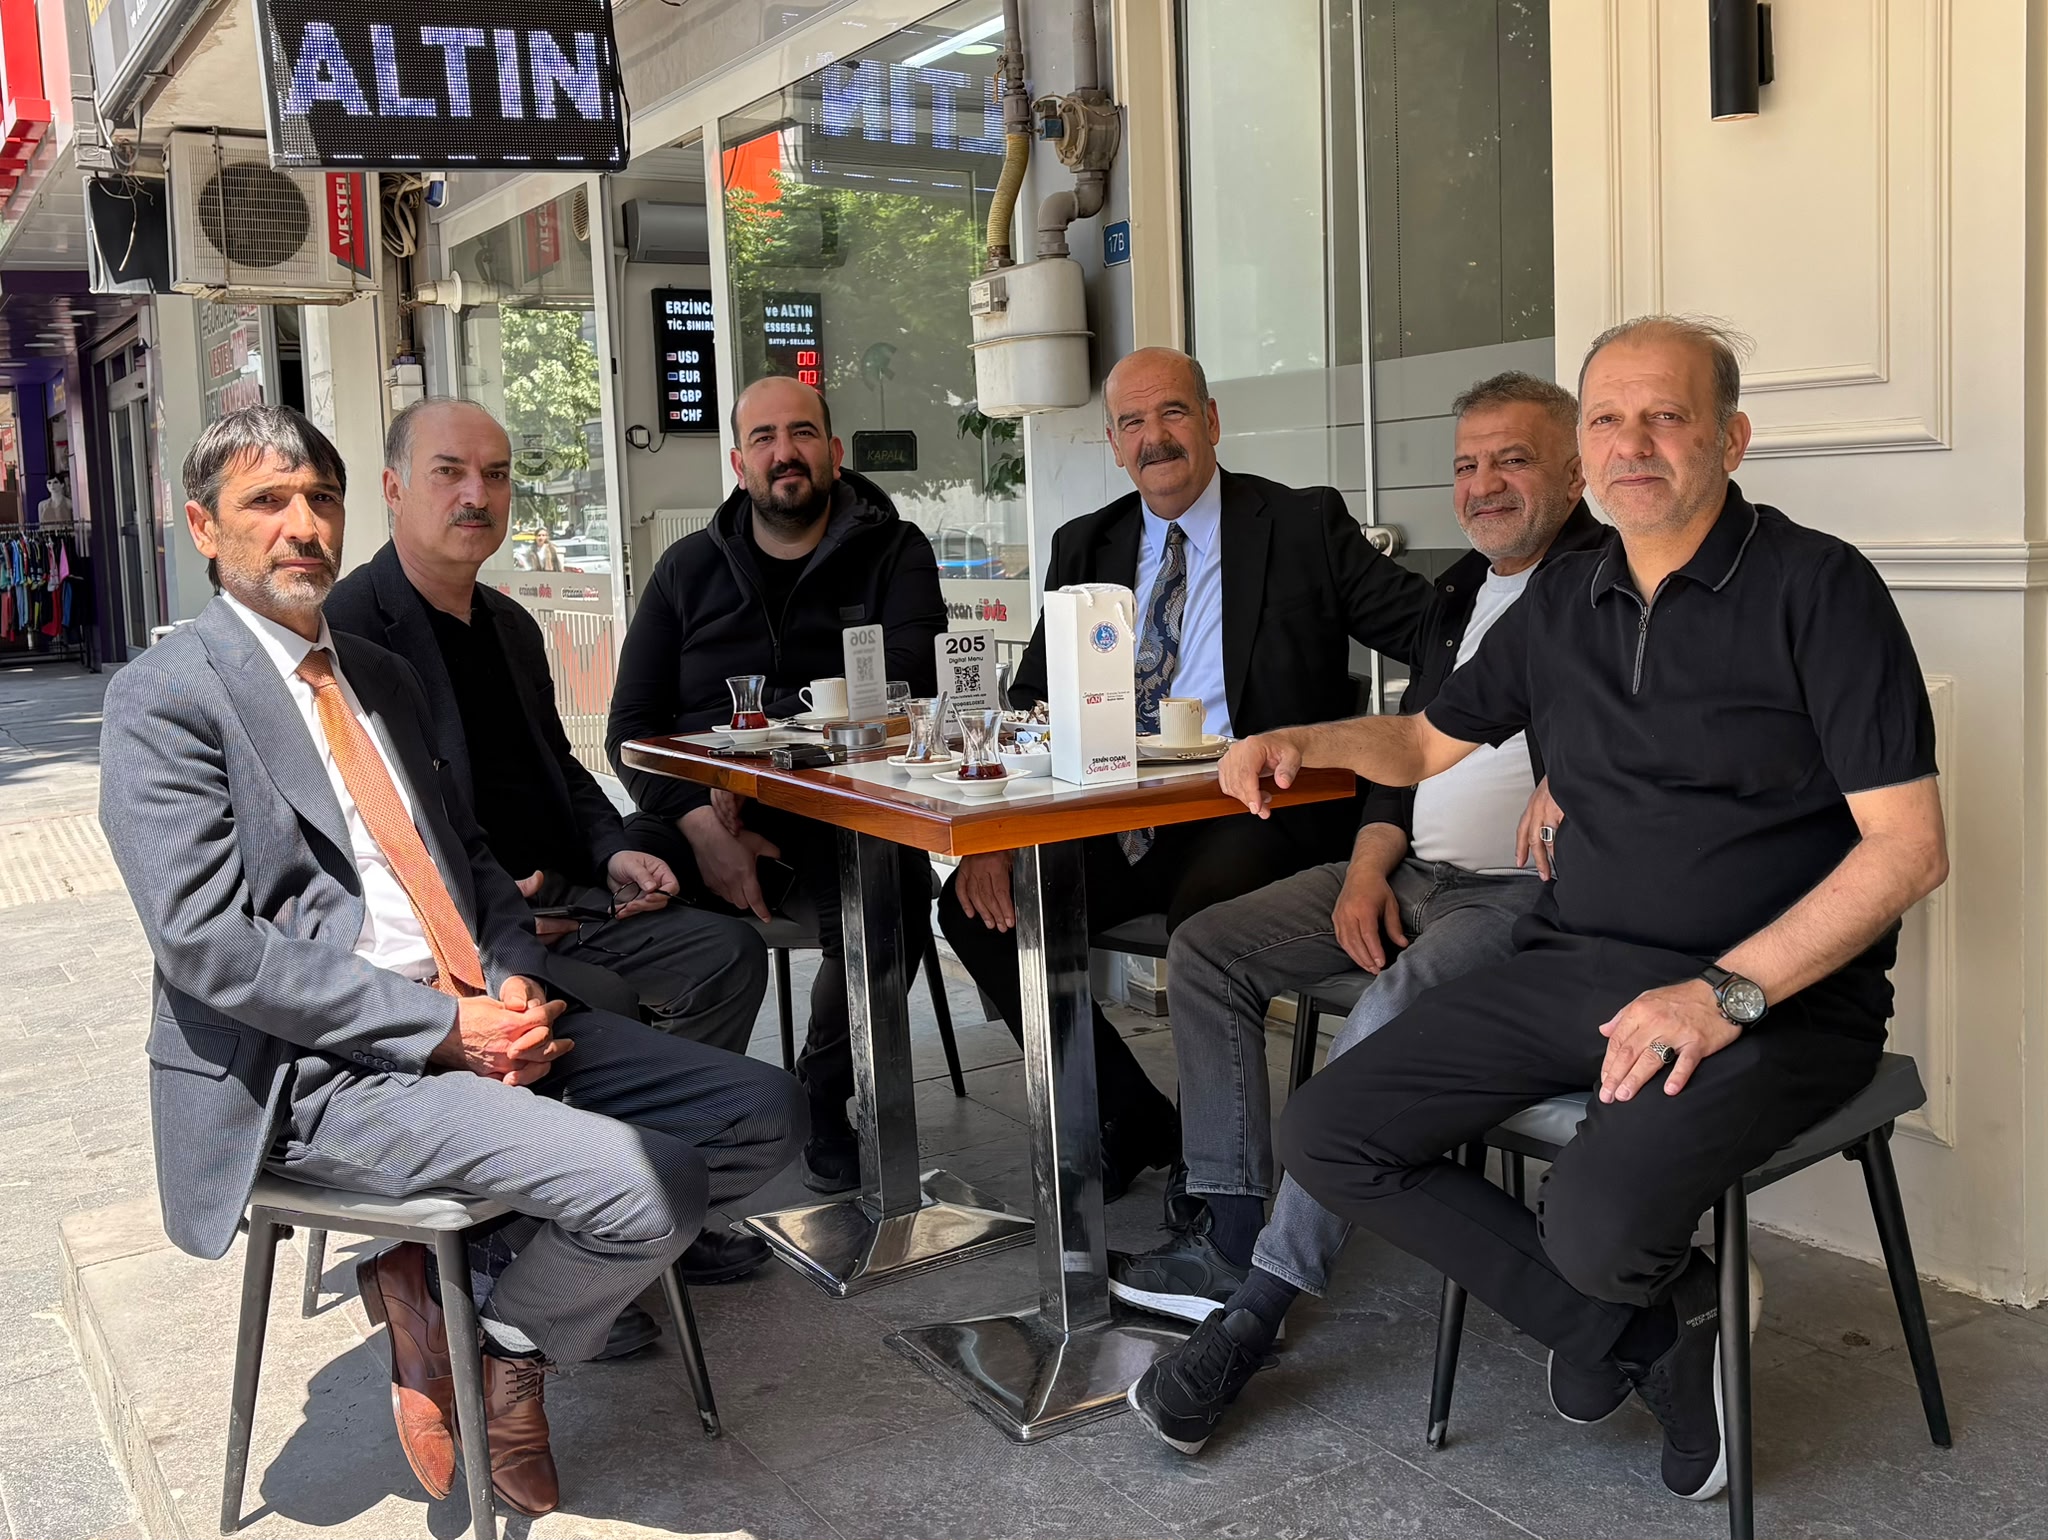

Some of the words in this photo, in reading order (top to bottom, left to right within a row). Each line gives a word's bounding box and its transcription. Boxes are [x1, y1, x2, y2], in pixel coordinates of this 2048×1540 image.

[282, 21, 603, 120] ALTIN
[1107, 232, 1125, 254] 17B
[764, 306, 779, 317] ve
[780, 304, 813, 318] ALTIN
[677, 350, 700, 364] USD
[678, 369, 701, 383] EUR
[679, 389, 702, 403] GBP
[680, 408, 703, 422] CHF
[945, 635, 986, 655] 205
[948, 657, 967, 665] Digital
